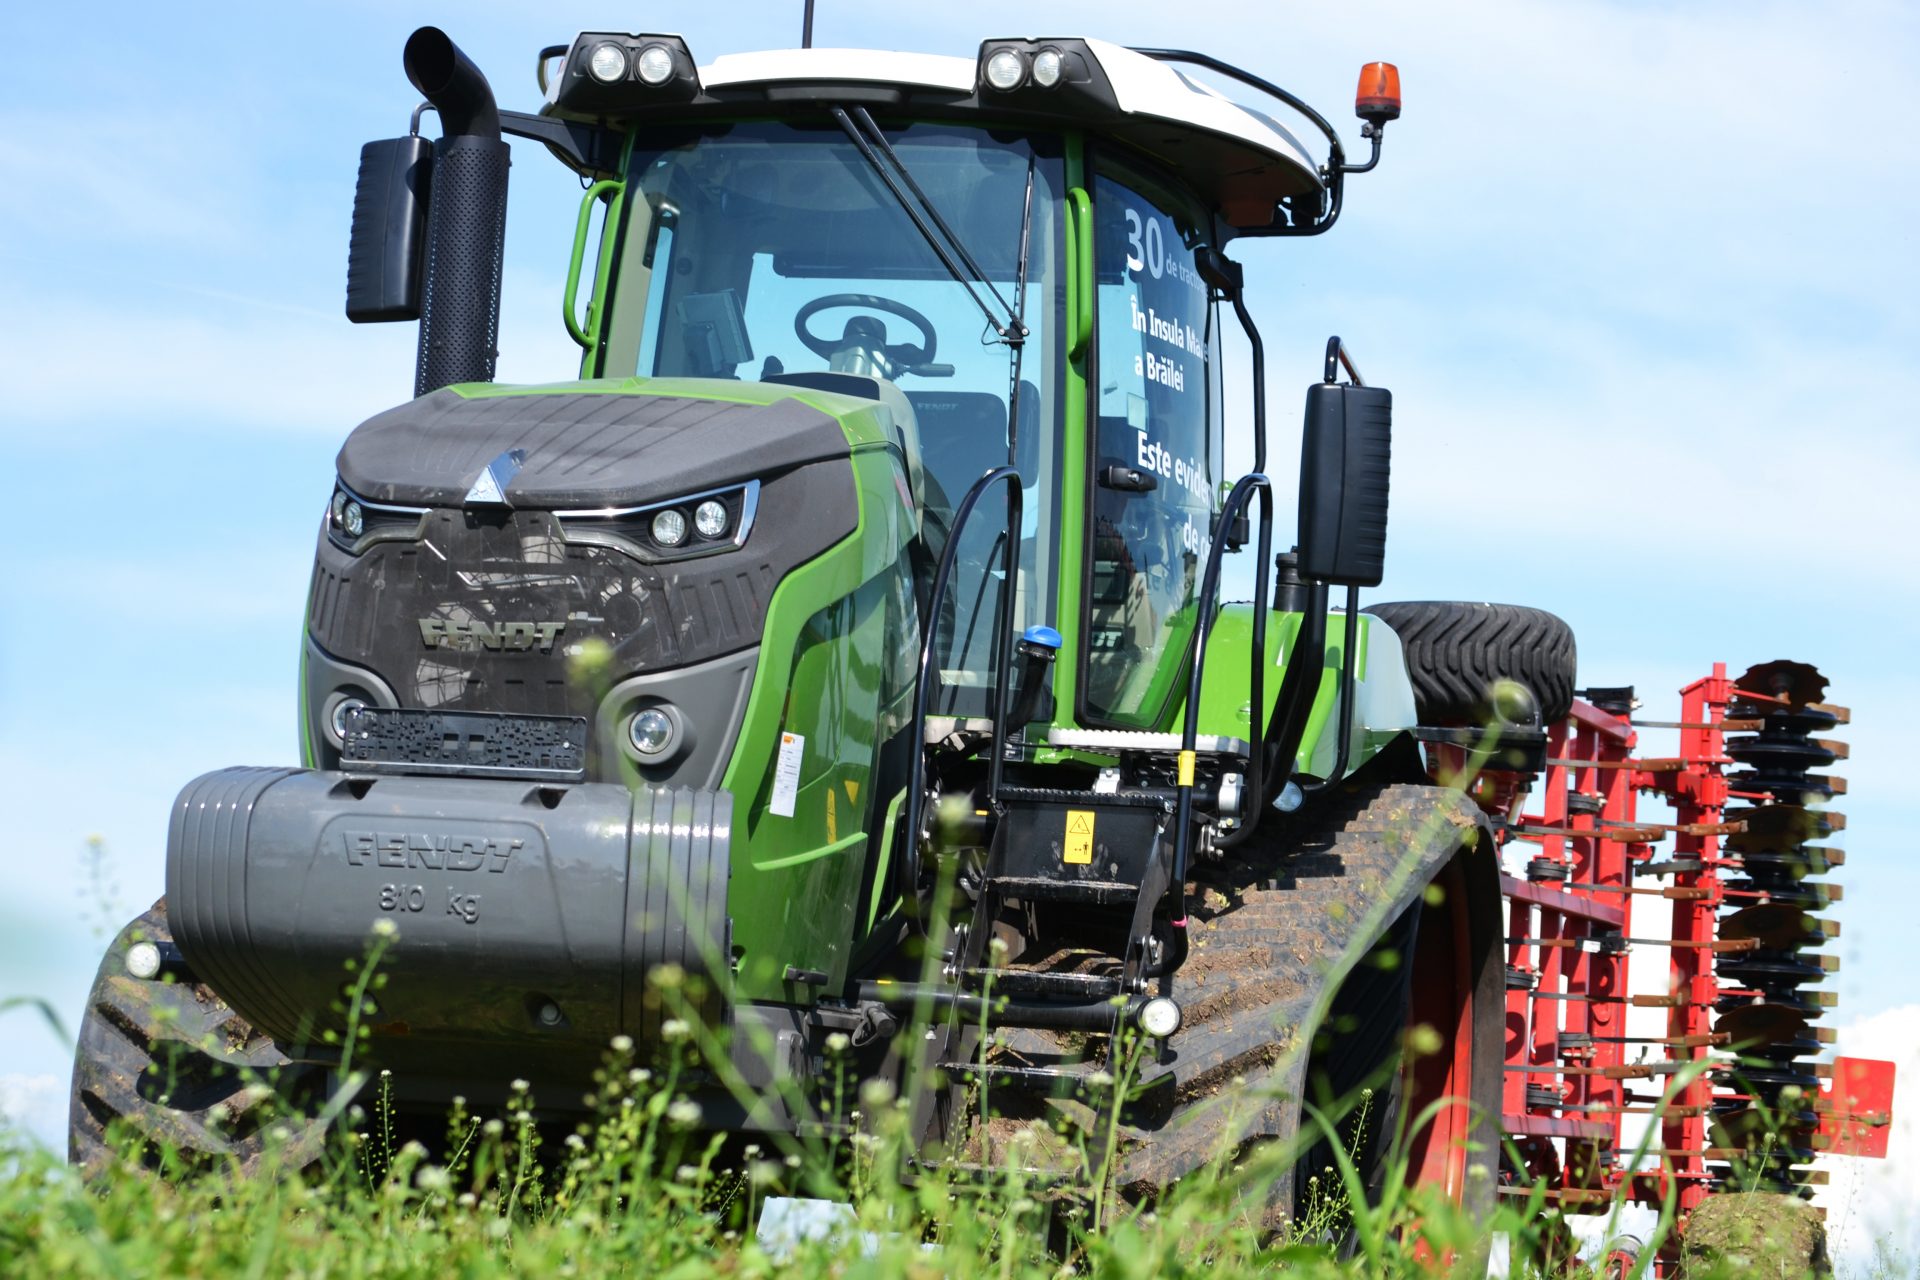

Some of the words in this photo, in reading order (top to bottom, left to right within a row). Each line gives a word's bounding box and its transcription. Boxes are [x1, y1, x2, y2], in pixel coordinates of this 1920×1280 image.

[1125, 208, 1164, 280] 30
[1166, 252, 1178, 278] de
[1148, 308, 1184, 349] Insula
[1134, 354, 1144, 377] a
[1146, 351, 1184, 393] Brăilei
[1137, 430, 1171, 479] Este
[1183, 513, 1198, 555] de
[418, 618, 566, 654] FENDT
[343, 831, 524, 874] FENDT
[379, 883, 425, 912] 810
[446, 885, 481, 925] kg
